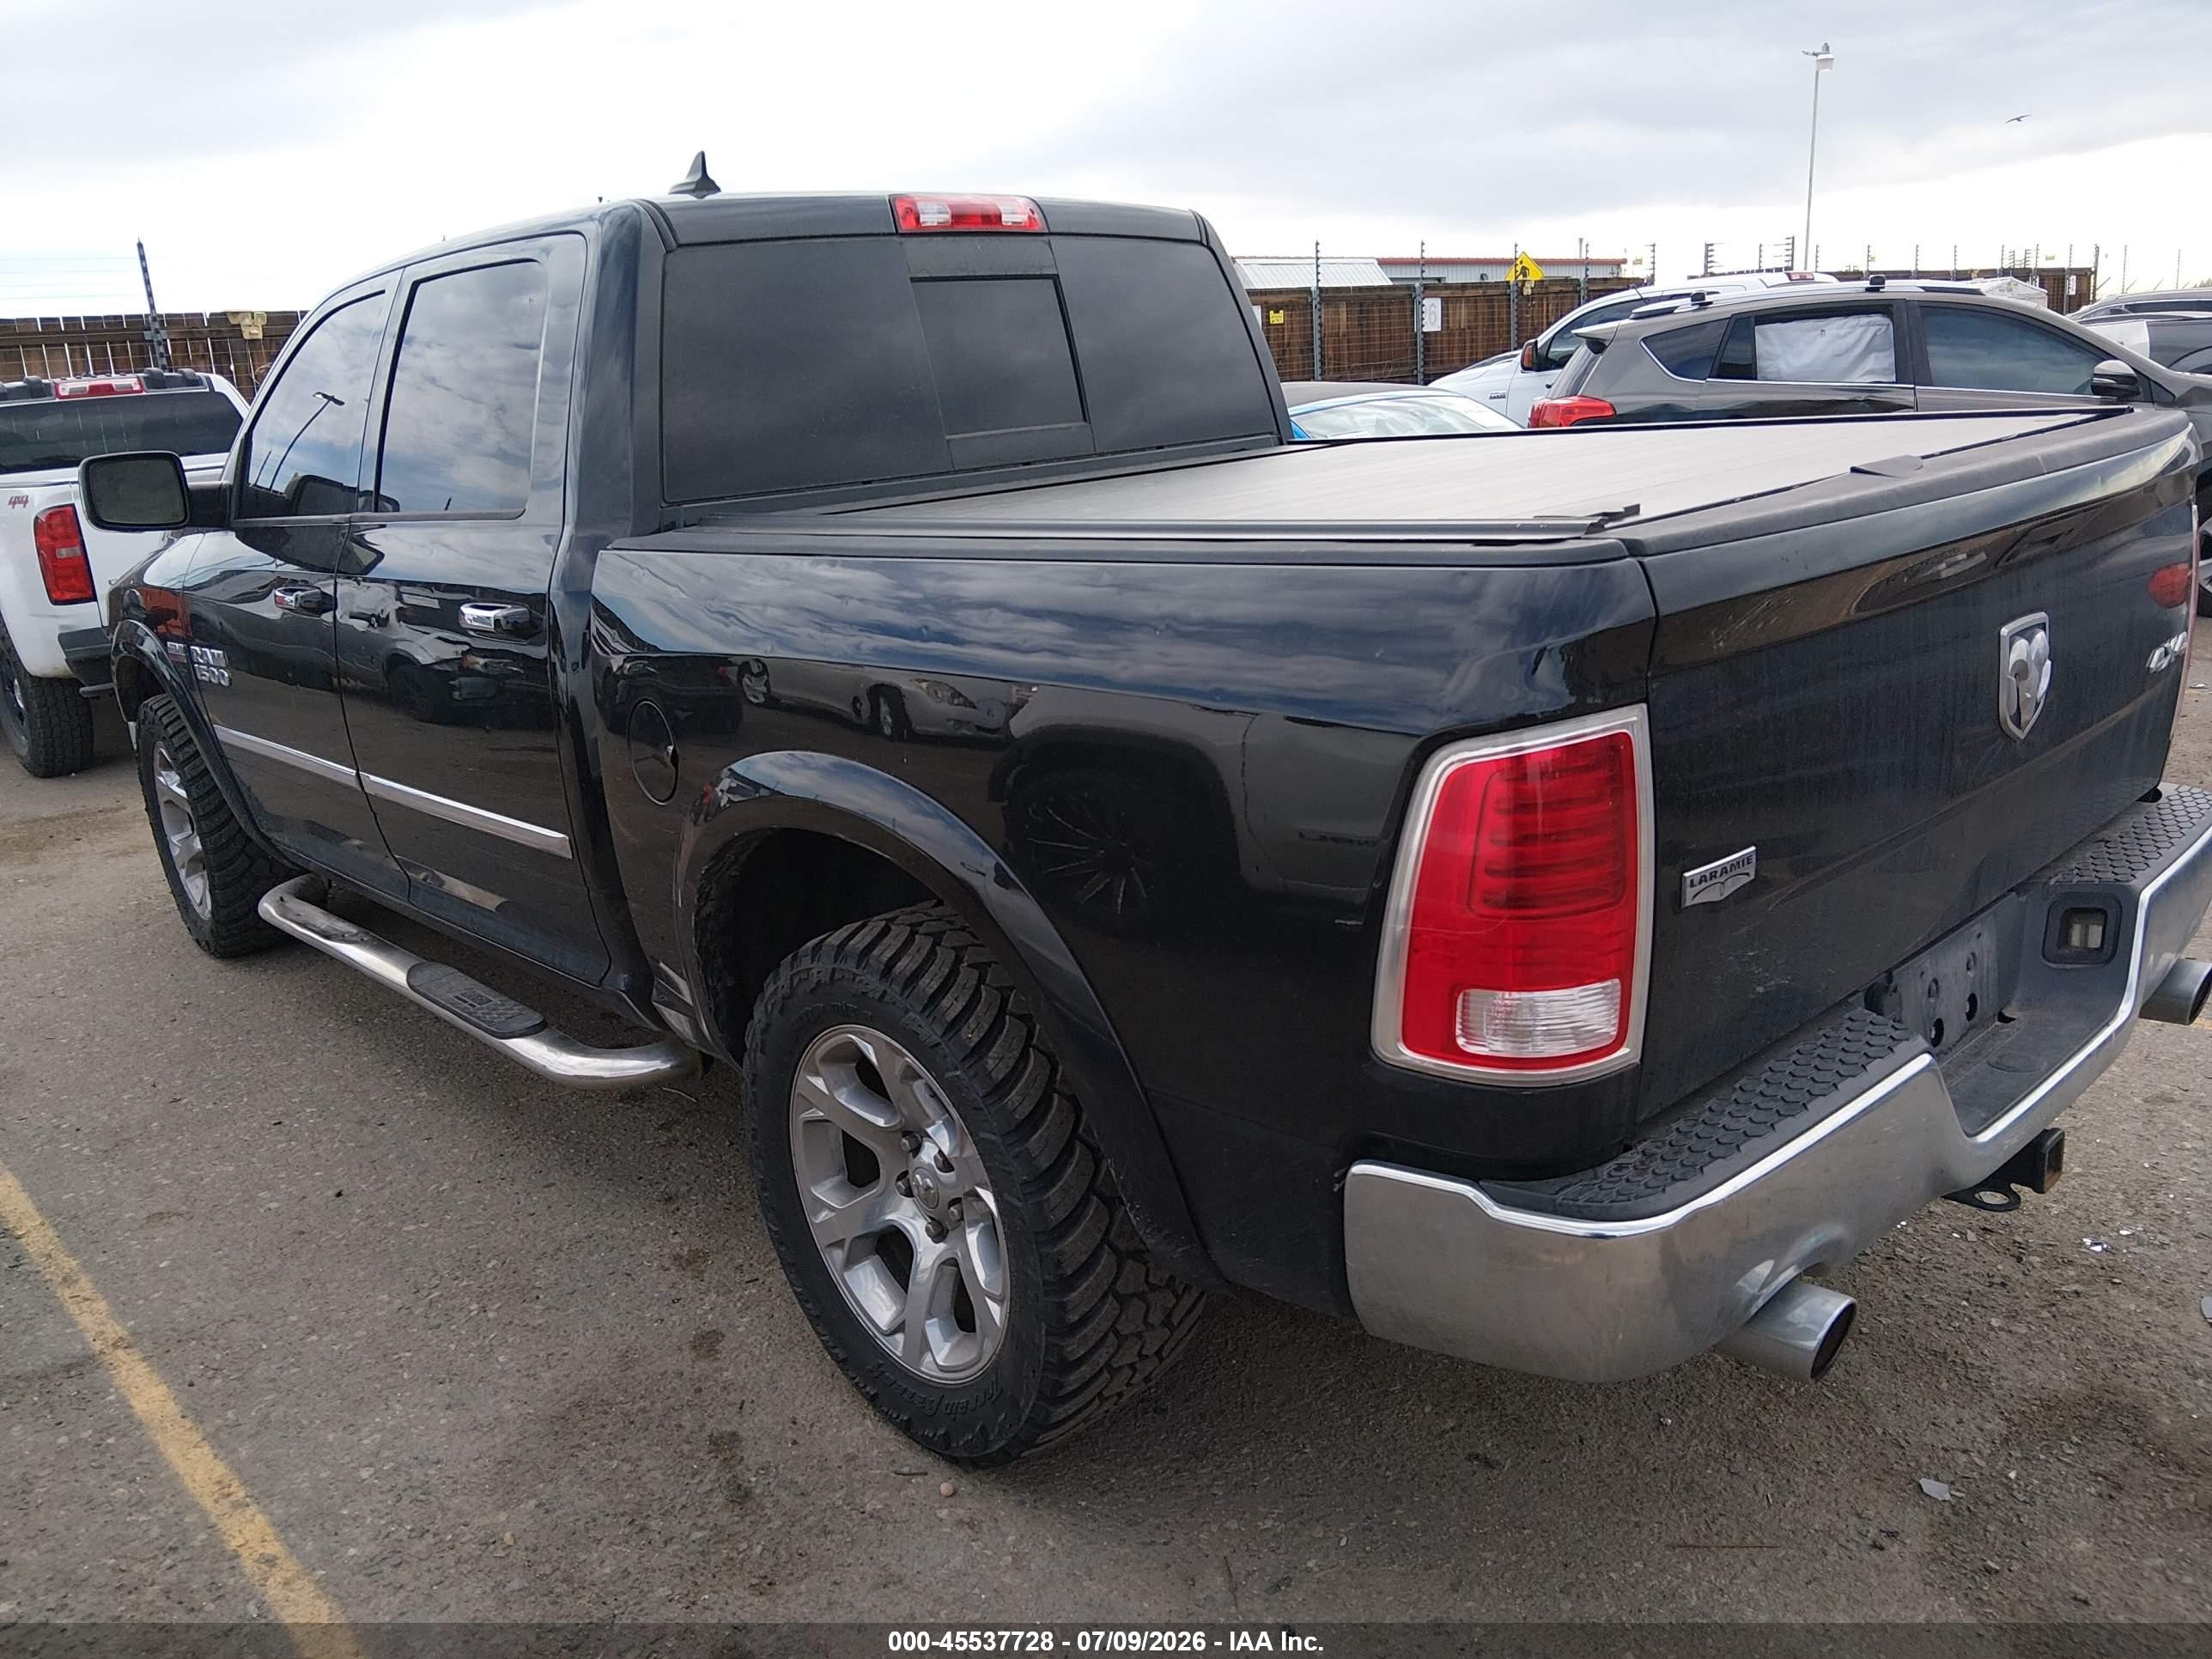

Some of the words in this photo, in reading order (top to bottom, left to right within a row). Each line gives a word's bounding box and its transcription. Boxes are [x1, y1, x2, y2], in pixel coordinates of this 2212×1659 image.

[190, 646, 228, 668] RAM
[193, 664, 232, 688] 1500
[1689, 854, 1754, 889] LARAMIE
